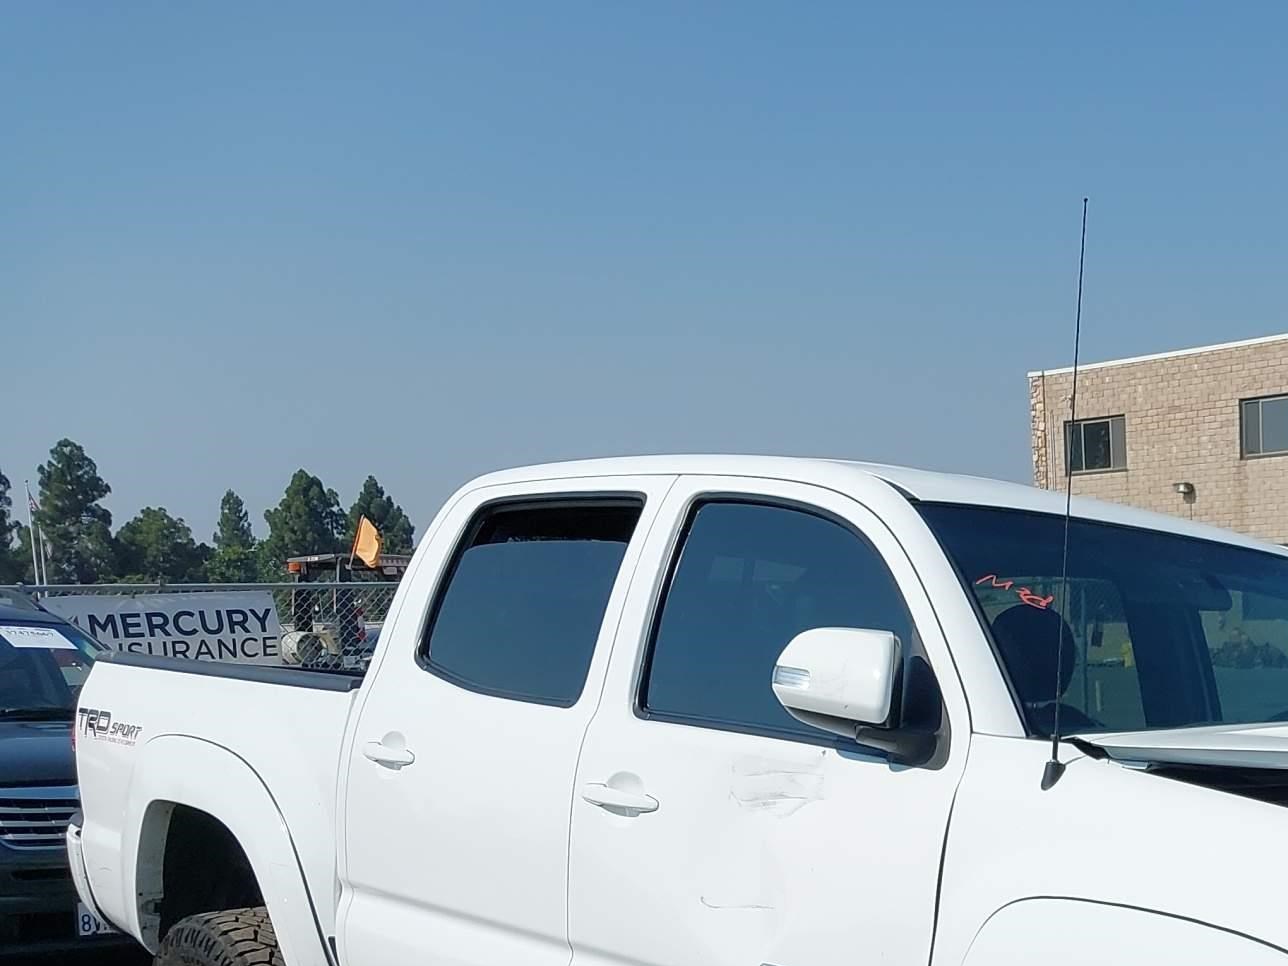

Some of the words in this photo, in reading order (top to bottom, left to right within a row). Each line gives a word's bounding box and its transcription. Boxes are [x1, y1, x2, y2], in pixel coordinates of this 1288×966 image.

[87, 608, 272, 640] MERCURY
[116, 636, 279, 660] SURANCE
[79, 708, 112, 737] TRD
[110, 722, 143, 740] SPORT
